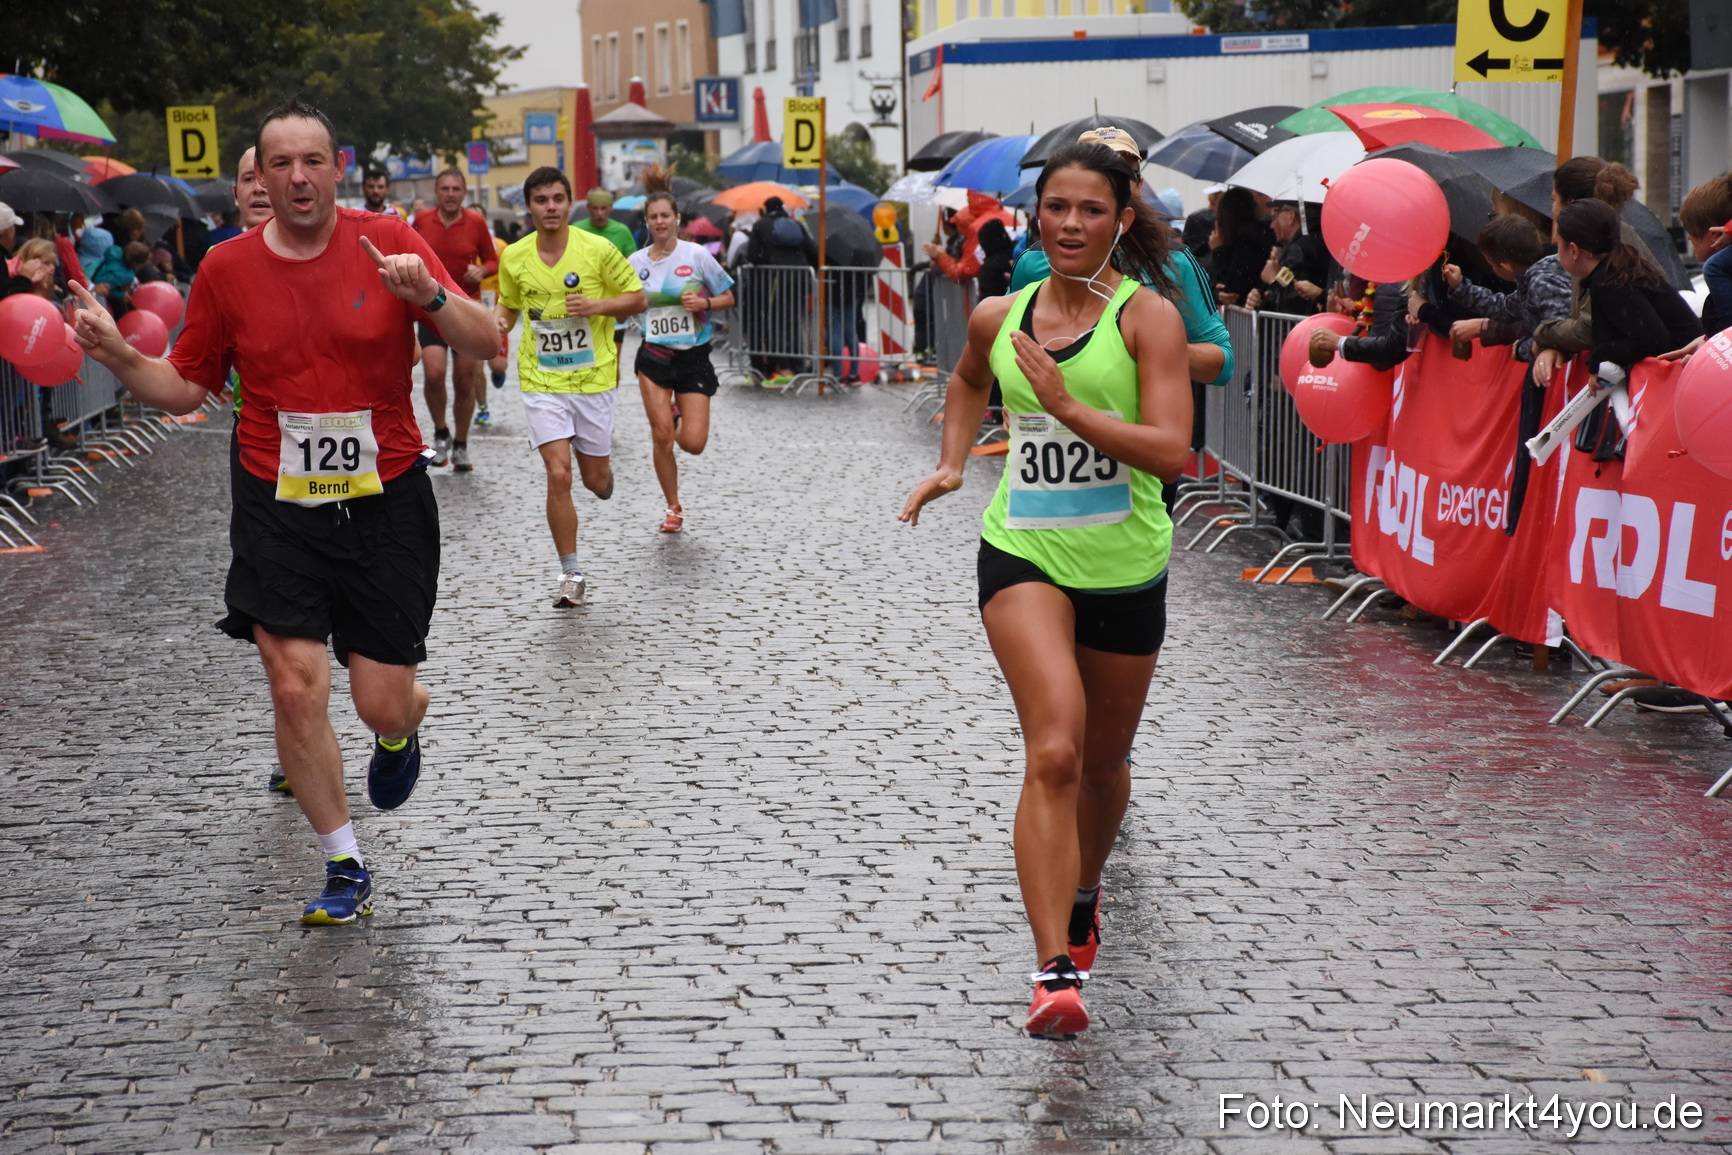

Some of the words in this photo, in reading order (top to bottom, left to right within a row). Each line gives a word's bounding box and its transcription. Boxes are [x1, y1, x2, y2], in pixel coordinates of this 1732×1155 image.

[789, 100, 821, 112] Block
[173, 109, 209, 123] Block
[795, 119, 815, 151] D
[182, 128, 206, 163] D
[651, 316, 690, 335] 3064
[540, 329, 588, 353] 2912
[557, 357, 573, 365] Max
[319, 416, 365, 428] BOCK
[298, 436, 361, 472] 129
[1020, 441, 1118, 484] 3025
[309, 480, 350, 495] Bernd
